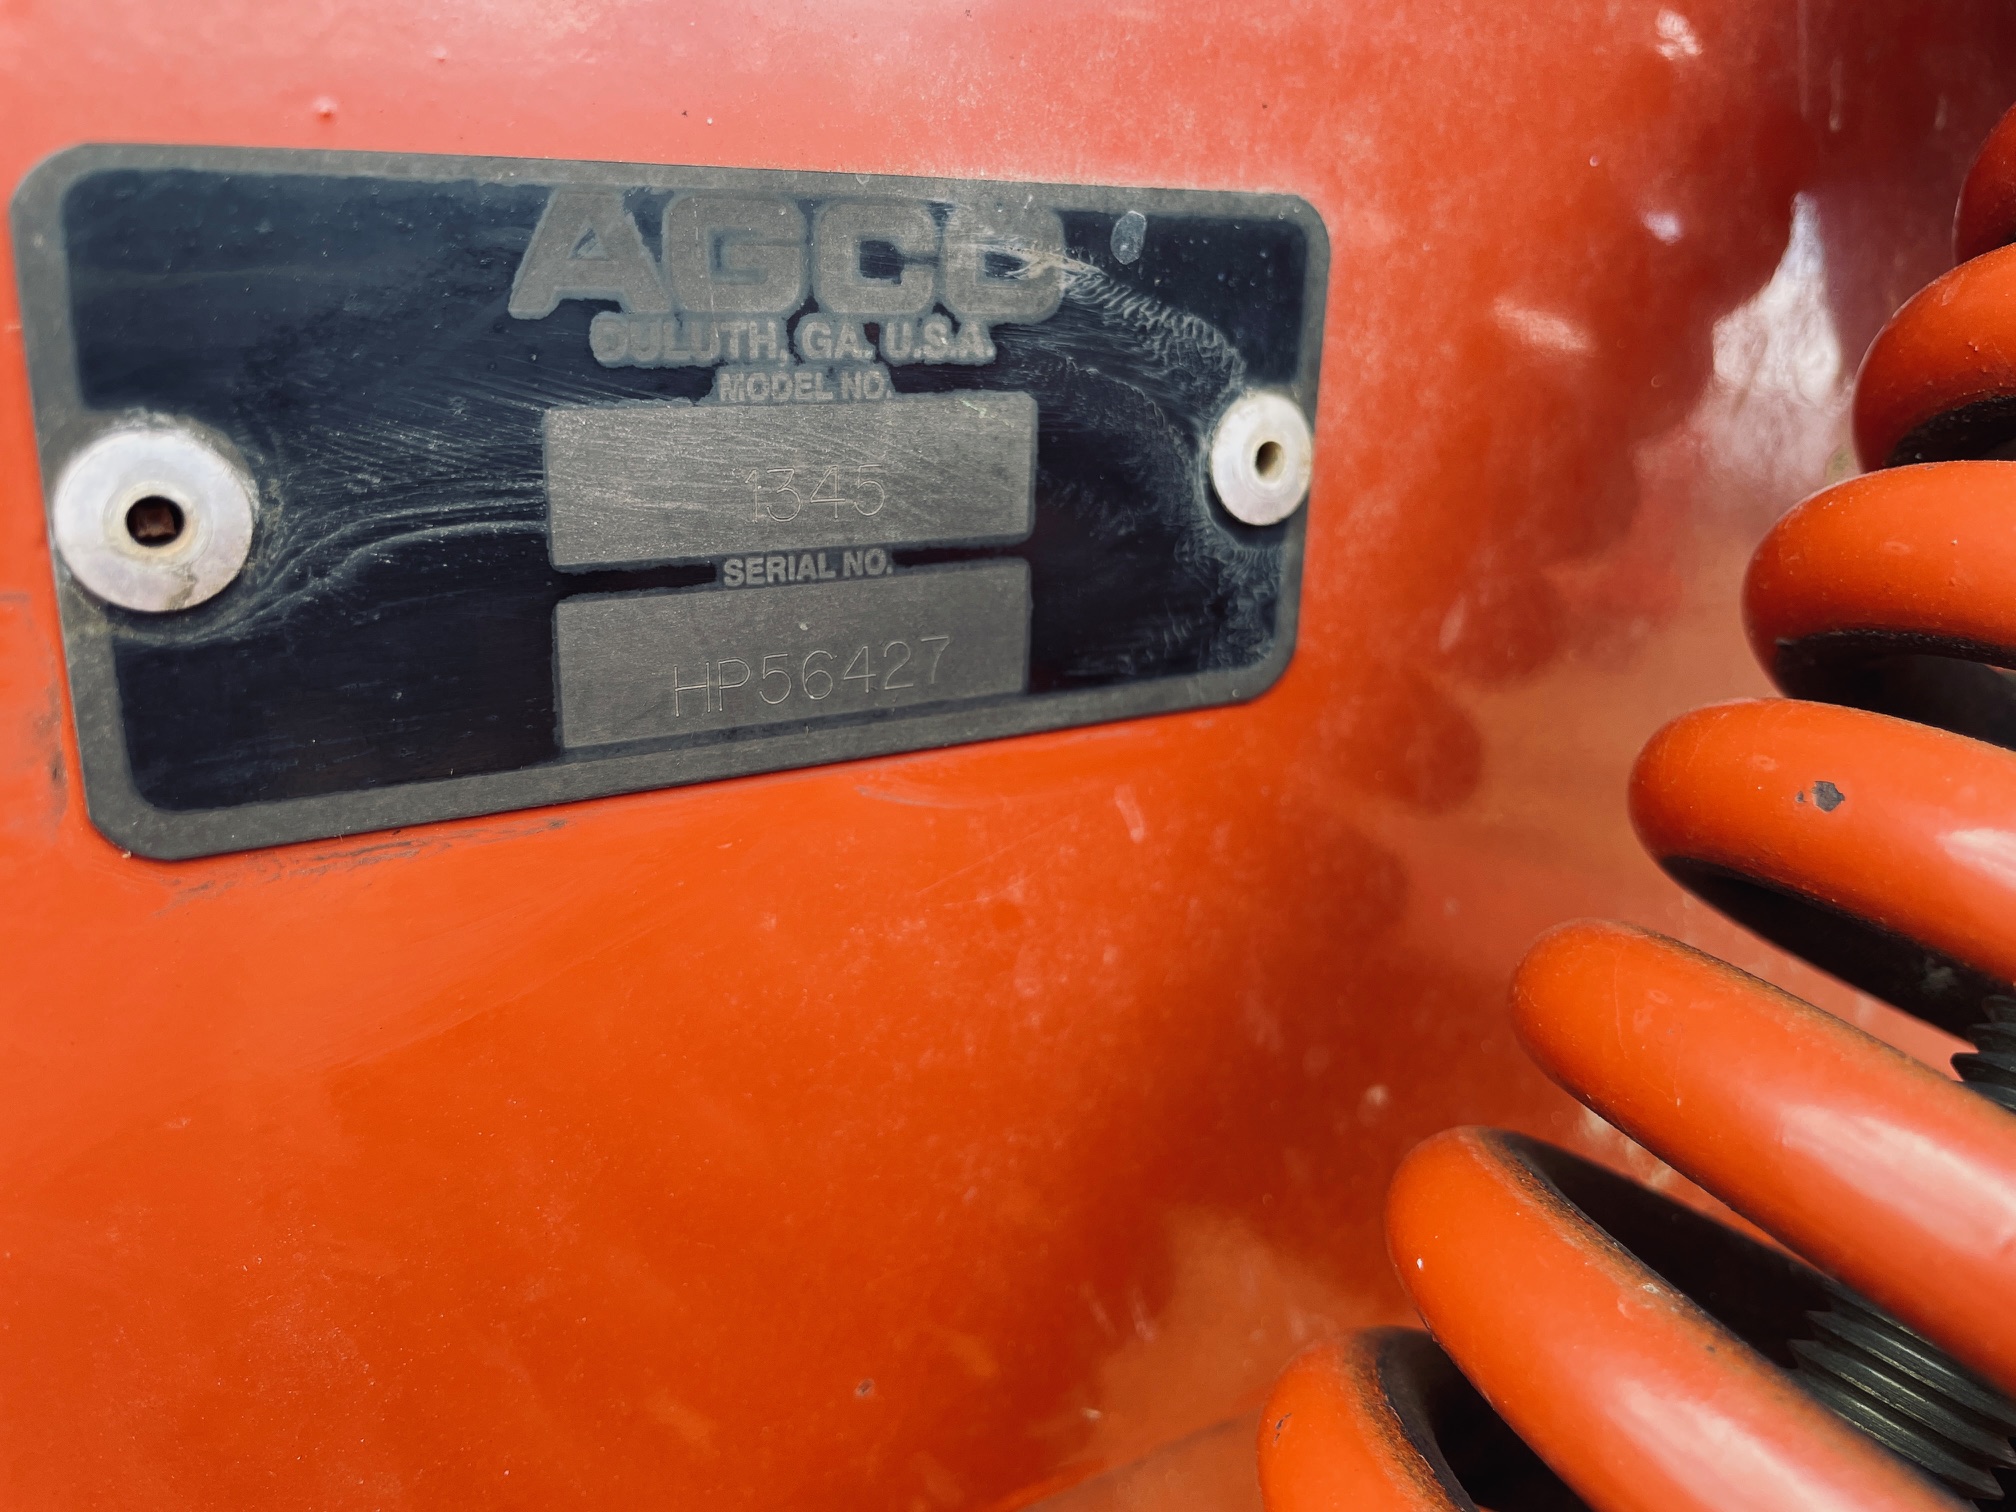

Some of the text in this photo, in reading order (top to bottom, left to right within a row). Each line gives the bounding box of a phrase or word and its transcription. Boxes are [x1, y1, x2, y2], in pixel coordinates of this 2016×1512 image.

[509, 188, 1065, 324] AGCO
[802, 326, 876, 361] GA.
[720, 372, 833, 401] MODEL
[744, 464, 886, 524] 1345
[723, 548, 893, 588] SERIAL NO.
[673, 635, 952, 718] HP56427
